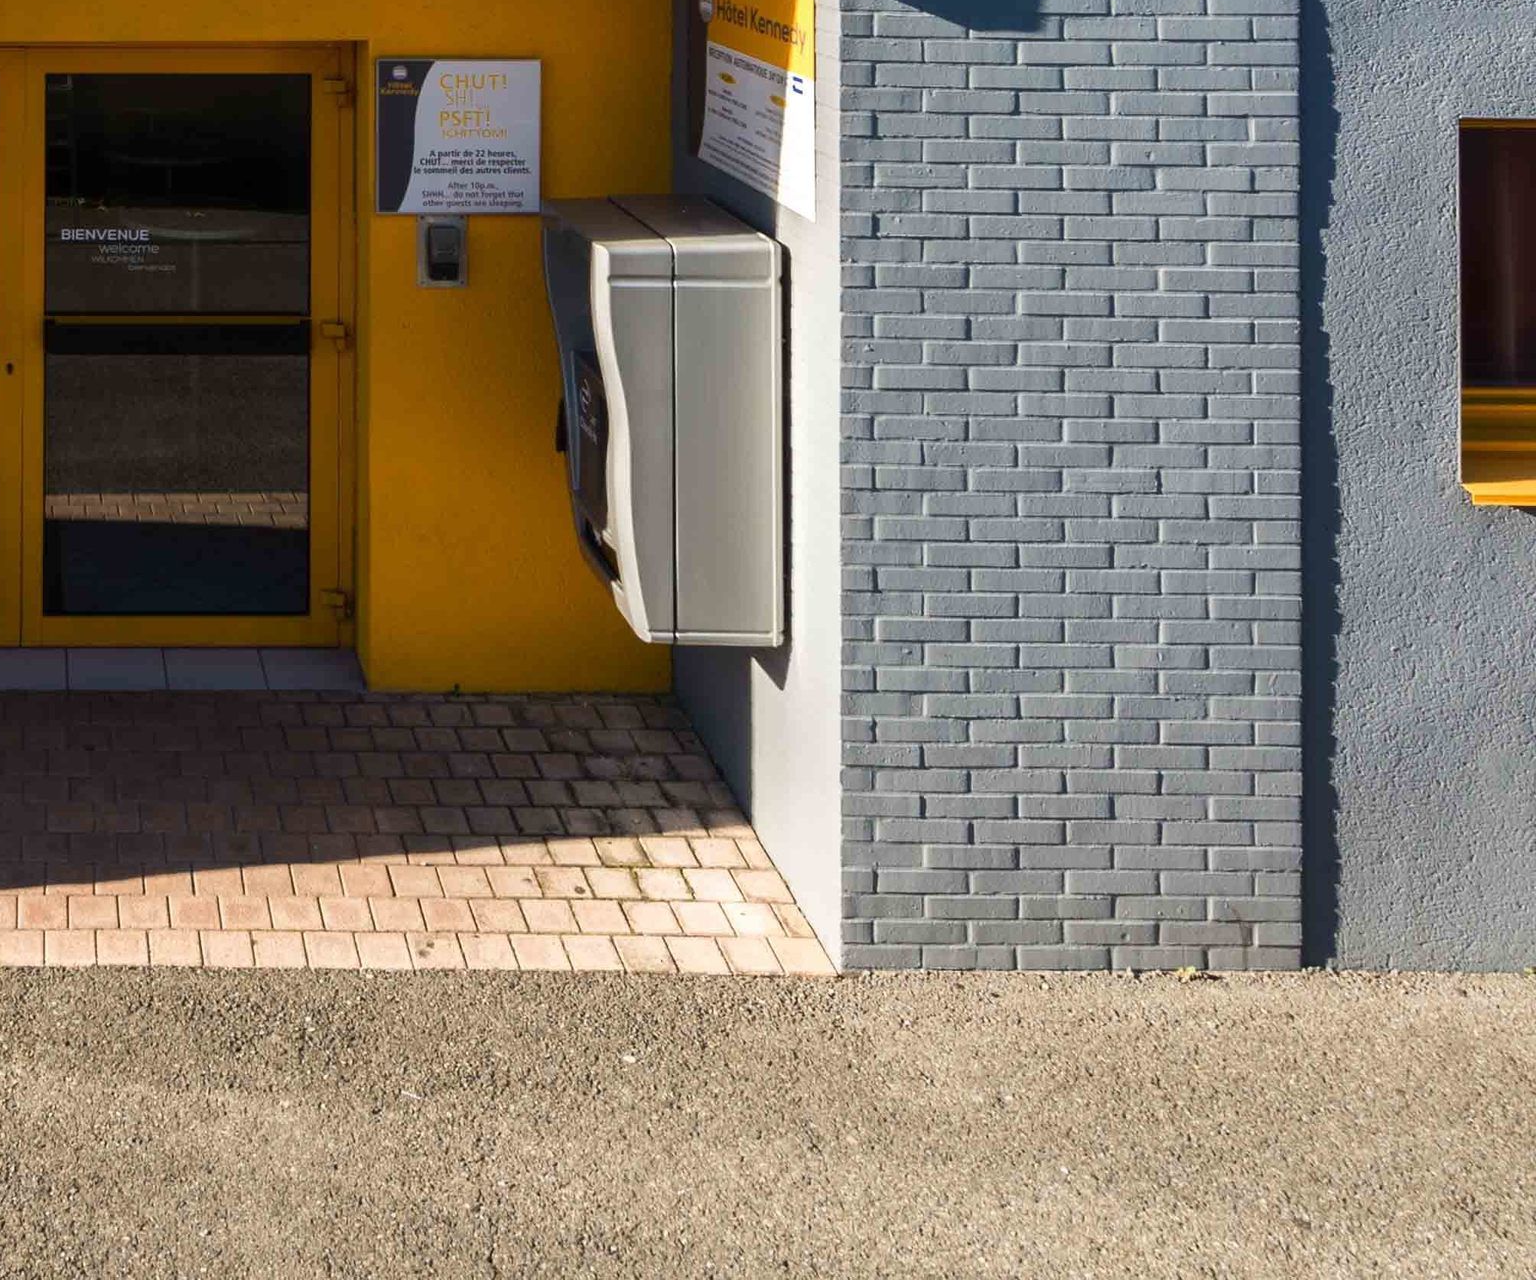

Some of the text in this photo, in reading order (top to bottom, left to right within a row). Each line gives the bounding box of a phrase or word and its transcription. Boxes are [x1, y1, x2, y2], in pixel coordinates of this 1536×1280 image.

[750, 7, 806, 54] Kennedy
[440, 74, 507, 90] CHUT!
[61, 229, 150, 241] BIENVENUE
[98, 243, 160, 254] welcome
